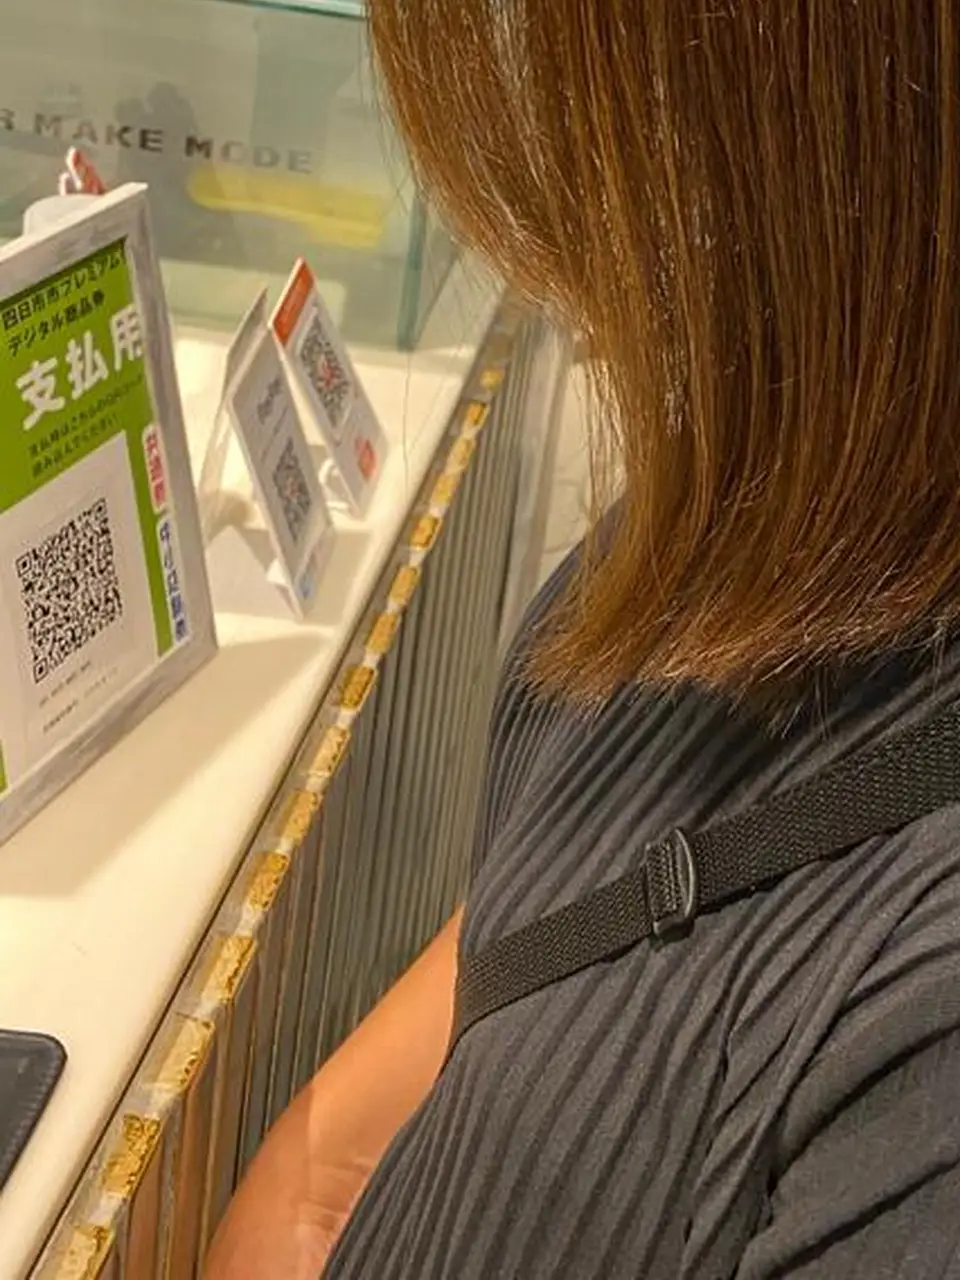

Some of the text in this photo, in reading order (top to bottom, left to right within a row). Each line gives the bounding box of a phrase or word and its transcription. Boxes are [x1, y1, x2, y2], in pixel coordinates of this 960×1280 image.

[33, 112, 165, 154] MAKE
[184, 133, 313, 175] MODE
[16, 302, 144, 431] 支払用
